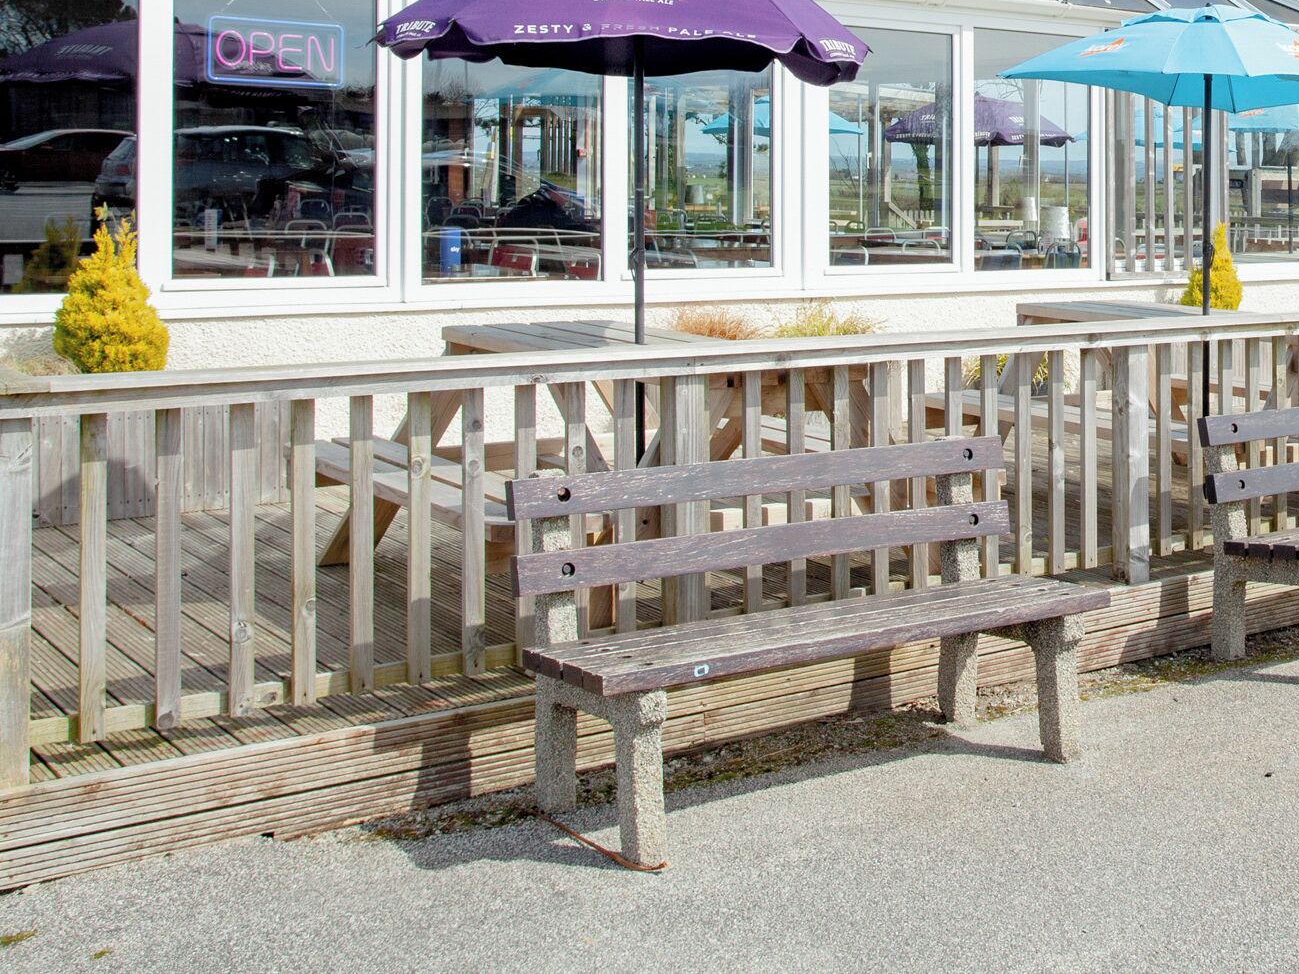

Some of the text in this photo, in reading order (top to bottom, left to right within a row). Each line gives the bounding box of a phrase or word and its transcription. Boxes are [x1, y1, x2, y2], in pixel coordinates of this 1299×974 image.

[395, 20, 436, 35] TRIBUTE
[513, 24, 574, 34] ZESTY
[582, 23, 593, 32] &
[668, 26, 714, 36] PALE
[214, 29, 336, 73] OPEN
[819, 39, 856, 56] TRIBUTE
